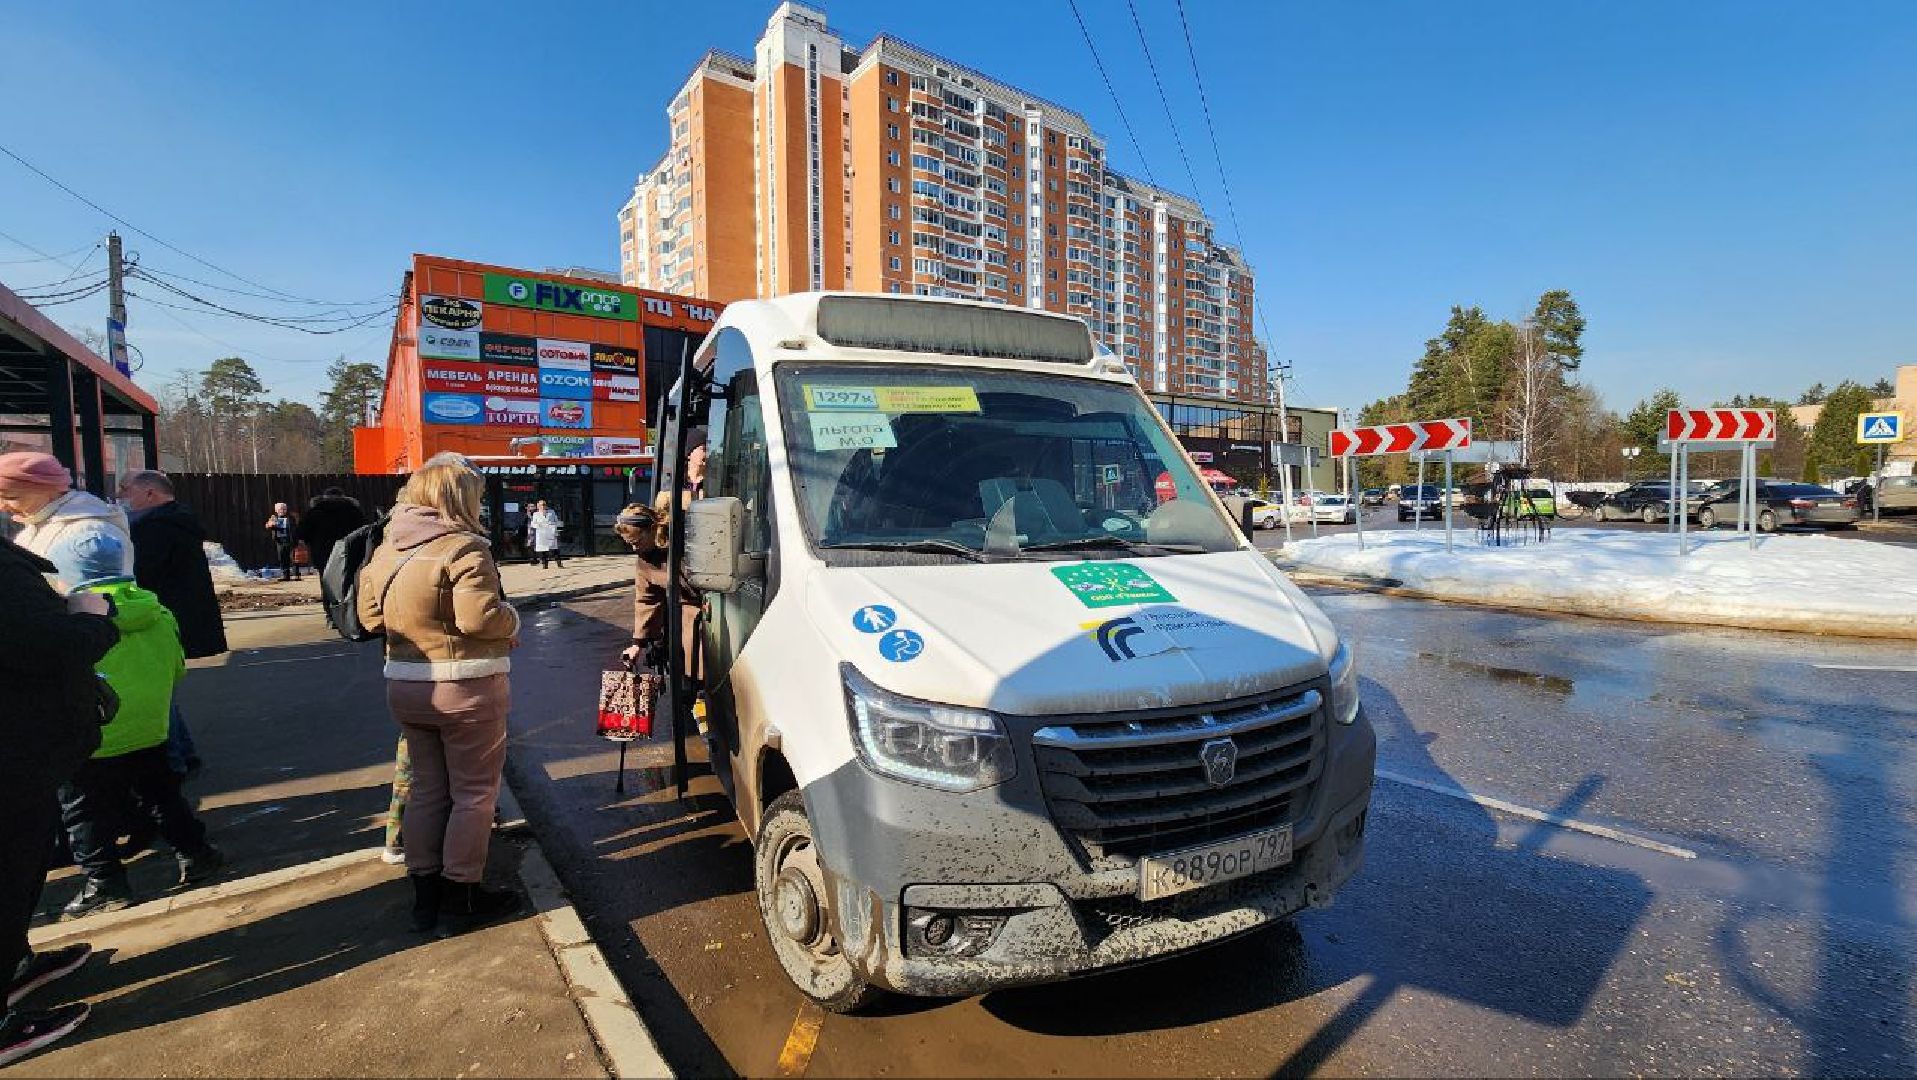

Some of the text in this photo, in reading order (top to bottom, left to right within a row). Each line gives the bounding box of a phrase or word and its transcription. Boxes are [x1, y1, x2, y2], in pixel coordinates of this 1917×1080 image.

[535, 282, 585, 312] FIX
[580, 291, 621, 307] price
[424, 304, 481, 319] ПЕКАРНЯ
[643, 297, 673, 317] ТЦ
[427, 369, 483, 382] МЕБЕЛЬ
[487, 370, 538, 384] АРЕНДА
[541, 373, 590, 387] OZON
[487, 412, 540, 424] ТОРТЫ
